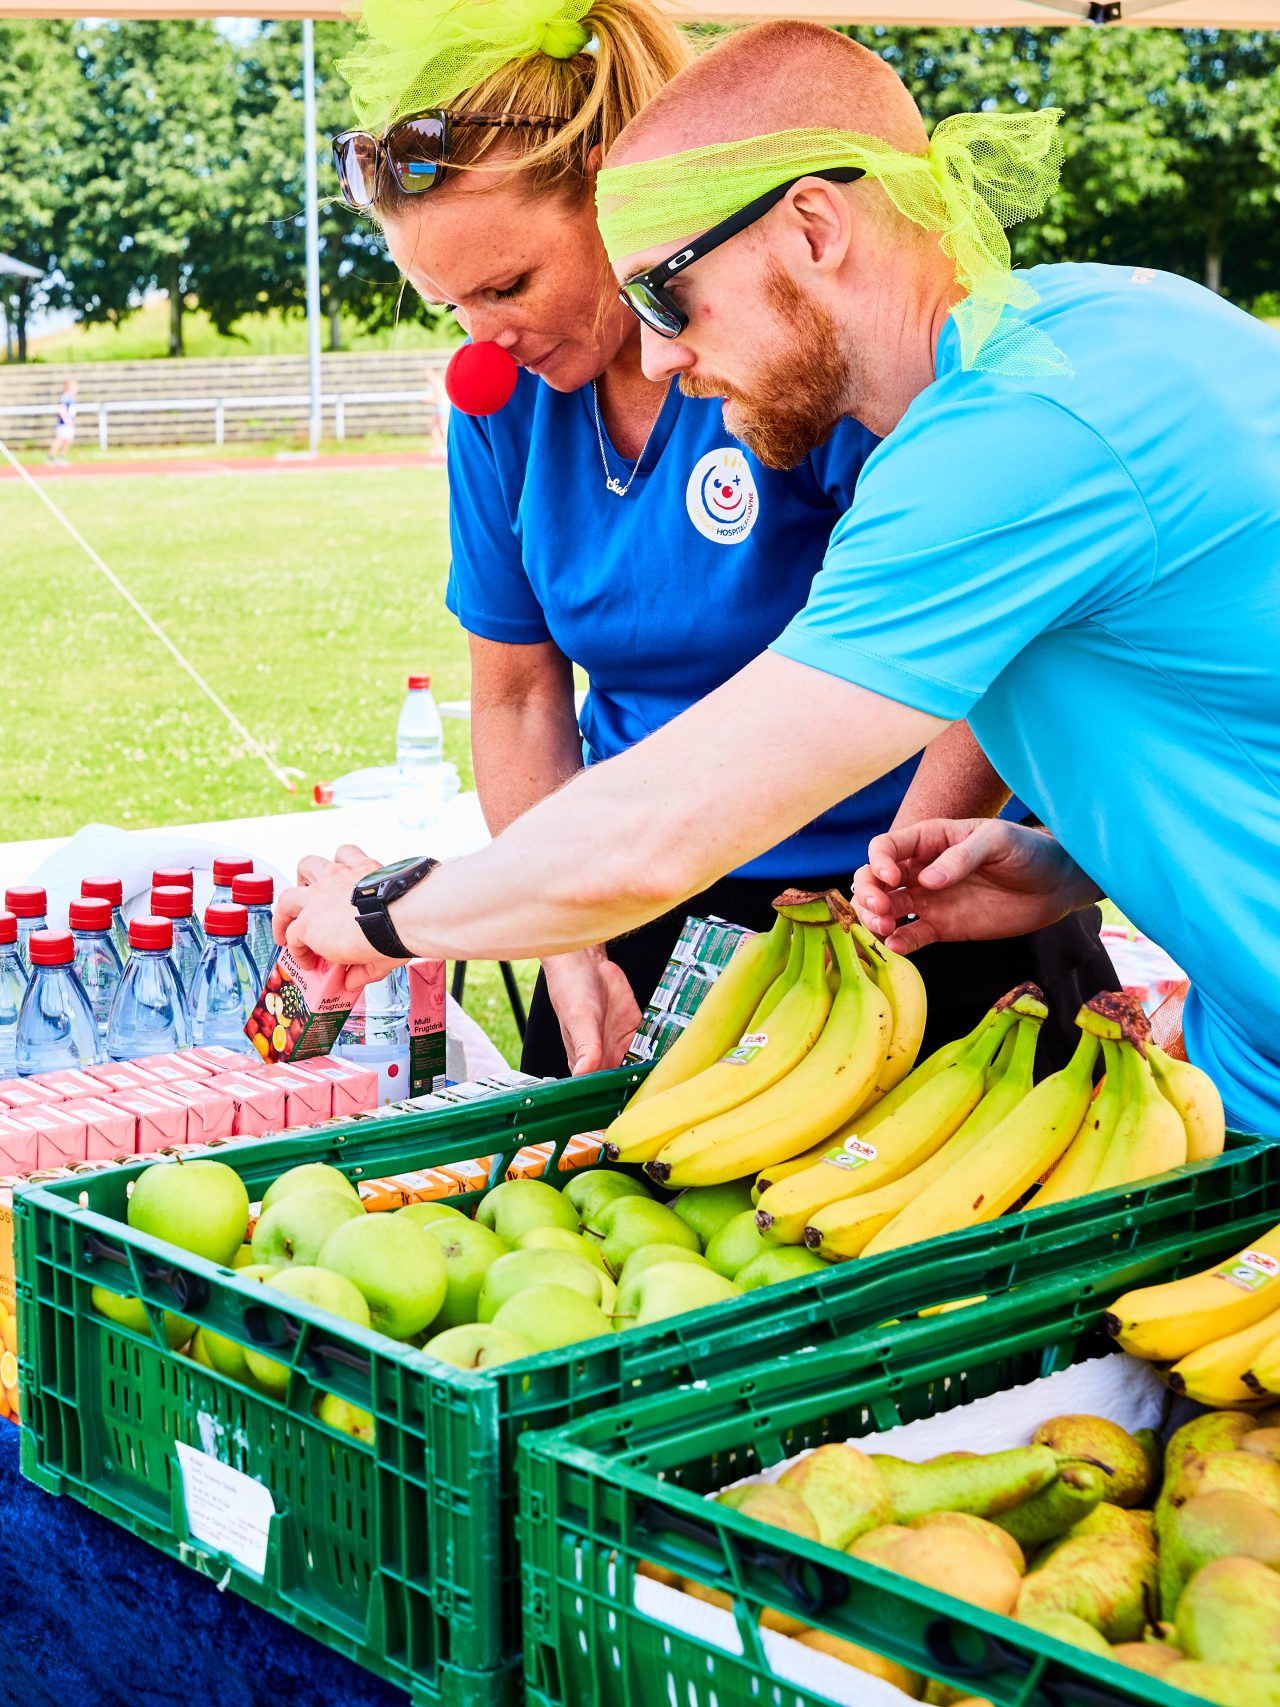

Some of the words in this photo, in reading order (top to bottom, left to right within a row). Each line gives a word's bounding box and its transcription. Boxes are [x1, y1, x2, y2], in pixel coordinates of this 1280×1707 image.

[321, 995, 341, 1004] Multi
[318, 1001, 352, 1011] Frugtdrik
[414, 1016, 431, 1026] Multi
[414, 1021, 444, 1033] Frugtdrik
